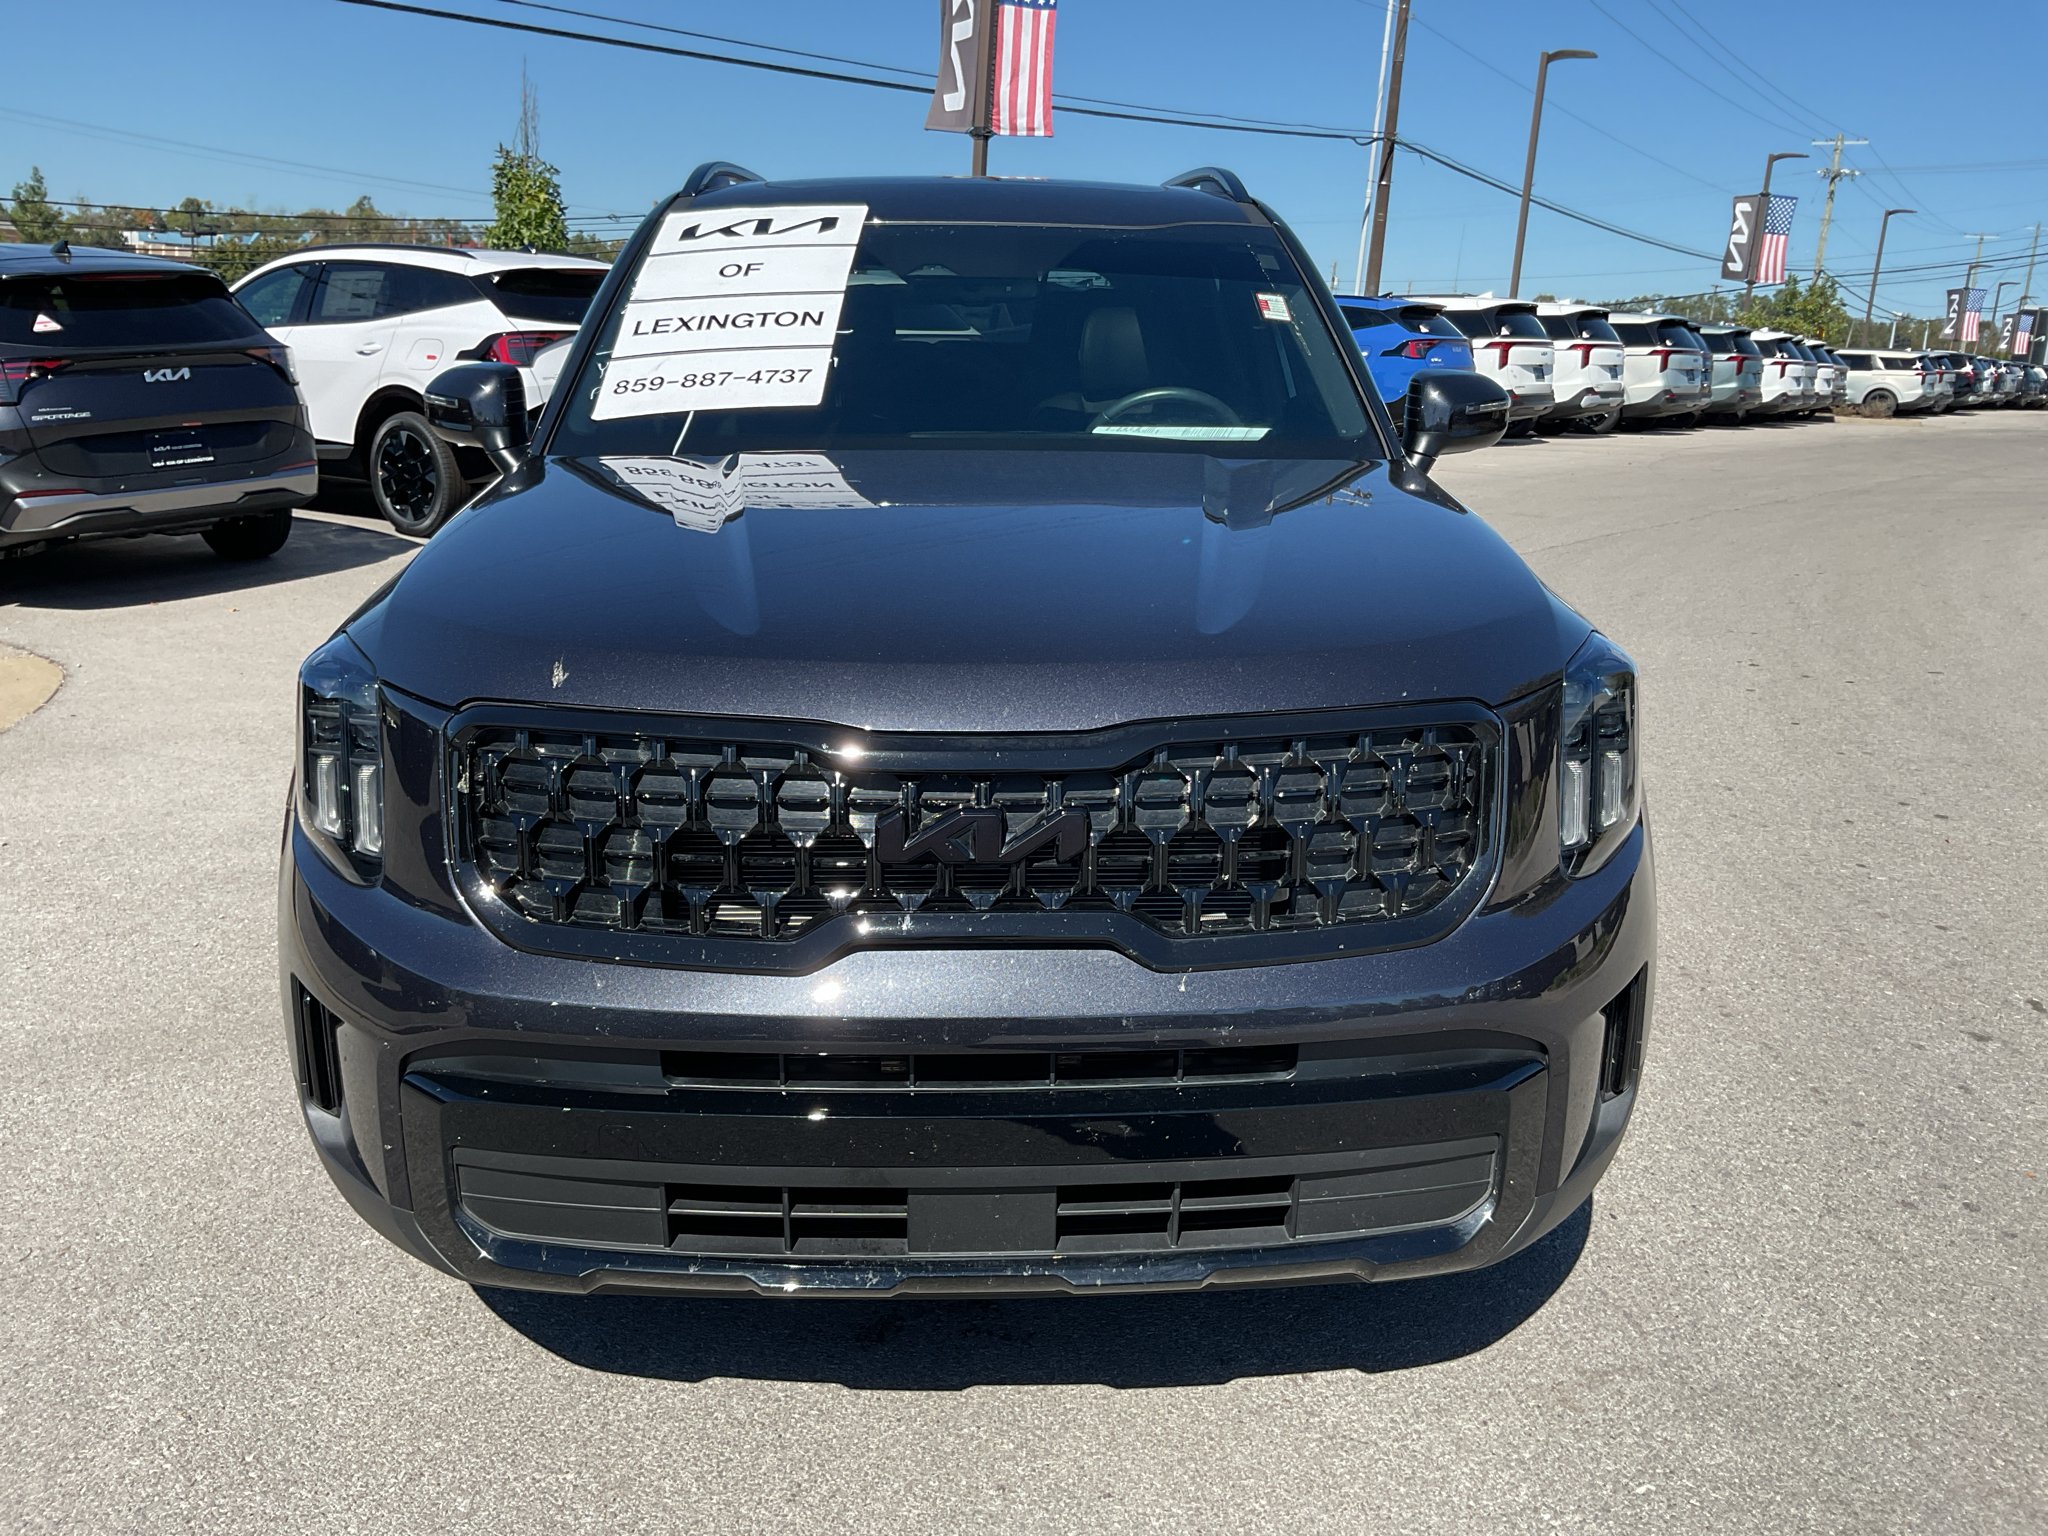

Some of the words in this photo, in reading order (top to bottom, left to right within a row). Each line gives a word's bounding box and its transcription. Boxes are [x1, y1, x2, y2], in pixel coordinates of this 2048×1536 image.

[679, 217, 839, 241] KIA
[1727, 202, 1752, 272] KIA
[718, 263, 764, 278] OF
[632, 311, 824, 336] LEXINGTON
[144, 367, 191, 383] KIA
[613, 369, 812, 395] 859-887-4737
[31, 411, 91, 421] SPORTAGE
[875, 804, 1091, 864] KIA
